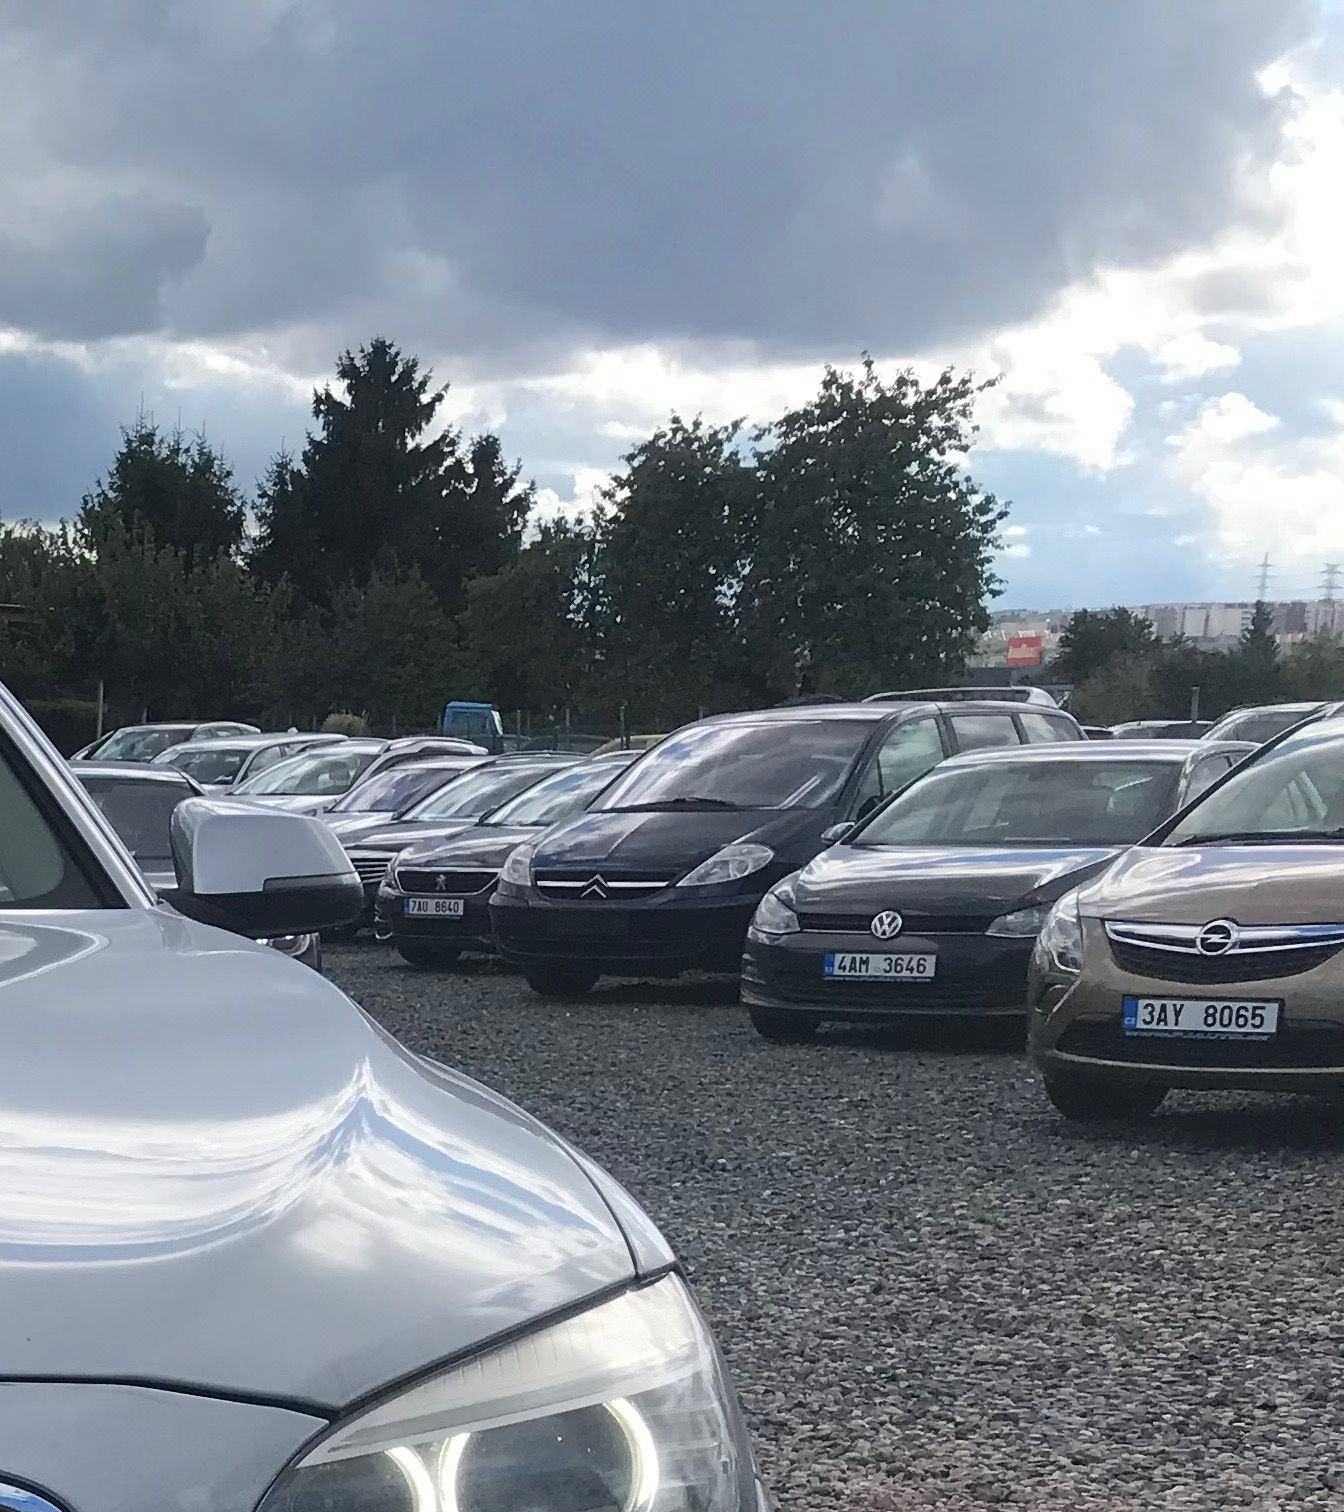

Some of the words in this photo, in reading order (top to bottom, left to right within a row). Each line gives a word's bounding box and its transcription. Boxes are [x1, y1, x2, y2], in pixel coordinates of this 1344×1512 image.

[838, 956, 870, 973] 4AM
[883, 957, 927, 974] 3646
[1142, 1003, 1185, 1026] 3AY
[1203, 1004, 1266, 1029] 8065
